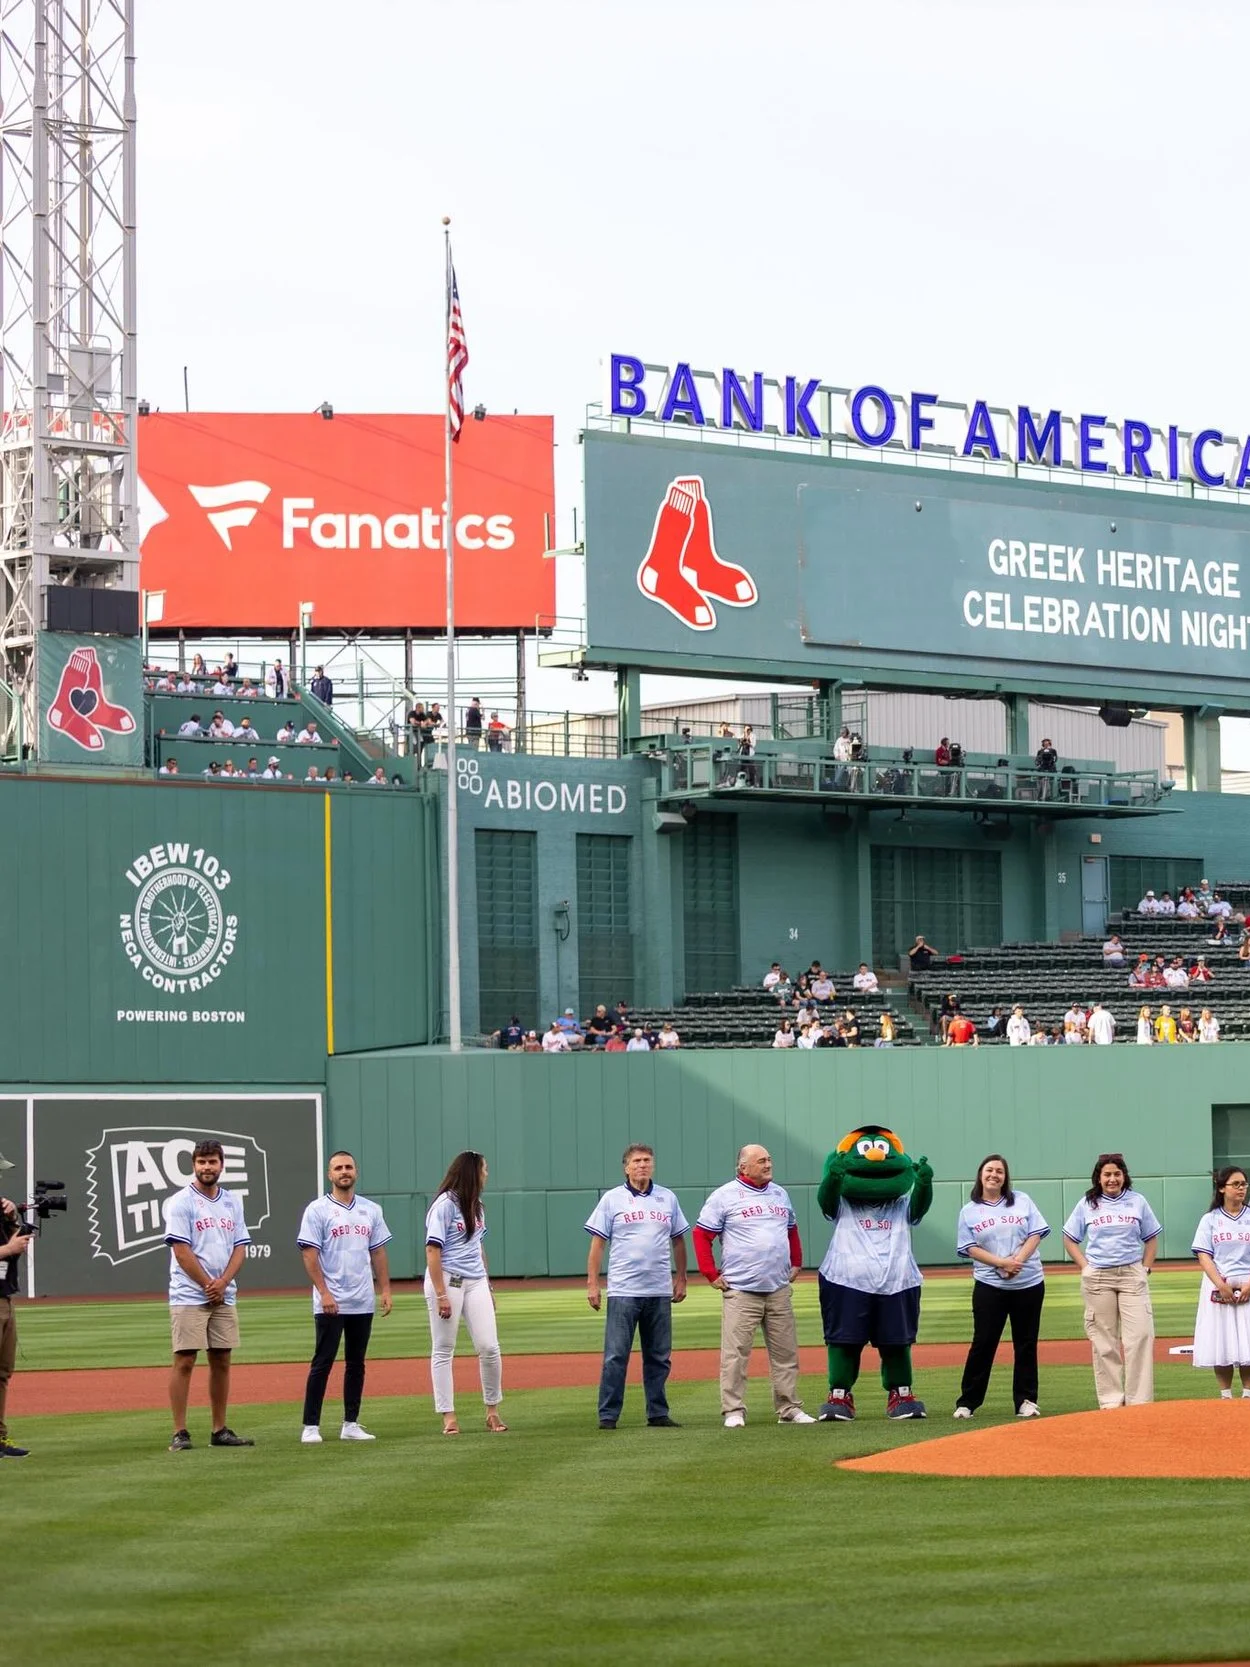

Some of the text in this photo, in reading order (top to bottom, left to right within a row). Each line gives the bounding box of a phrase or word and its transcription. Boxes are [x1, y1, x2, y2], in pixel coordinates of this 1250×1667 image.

[610, 353, 822, 440] BANK
[850, 385, 939, 450] OF
[282, 497, 516, 550] Fanatics
[988, 538, 1241, 599] GREEK HERITAGE
[963, 589, 1171, 644] CELEBRATION
[484, 779, 627, 814] ABIOMED
[125, 842, 231, 891] IBEW 103
[1058, 872, 1067, 884] 35
[197, 886, 219, 935] ELECTRICAL
[789, 927, 799, 941] 34
[120, 914, 239, 994] NECA CONTRACTORS
[117, 1010, 246, 1023] POWERING BOSTON
[624, 1210, 669, 1223] RED SOX
[742, 1205, 787, 1218] RED SOX
[331, 1224, 350, 1238] RED
[974, 1215, 1024, 1233] RED SOX
[1213, 1232, 1233, 1245] RED
[245, 1245, 271, 1259] 1979
